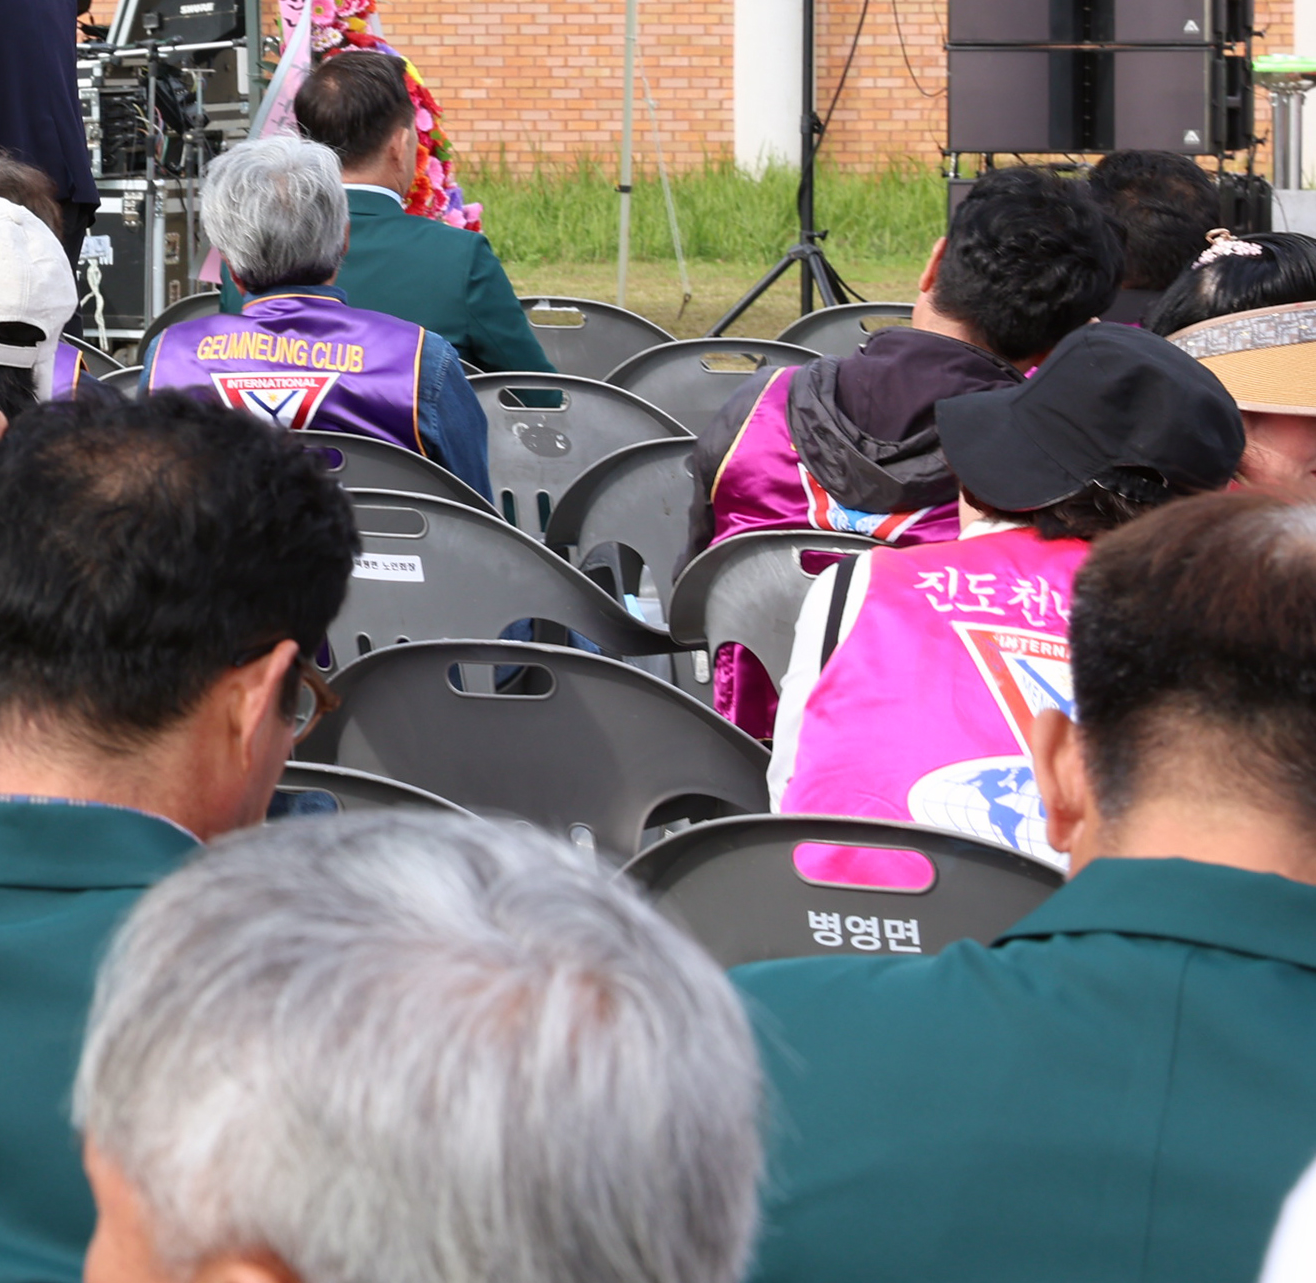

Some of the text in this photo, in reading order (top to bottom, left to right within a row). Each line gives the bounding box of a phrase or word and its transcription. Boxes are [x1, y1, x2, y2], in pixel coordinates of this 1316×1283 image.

[196, 331, 365, 373] GEUMNEUNG CLUB
[226, 378, 319, 389] INTERNATIONAL
[914, 566, 1005, 615] 진도
[808, 911, 921, 954] 병영면
